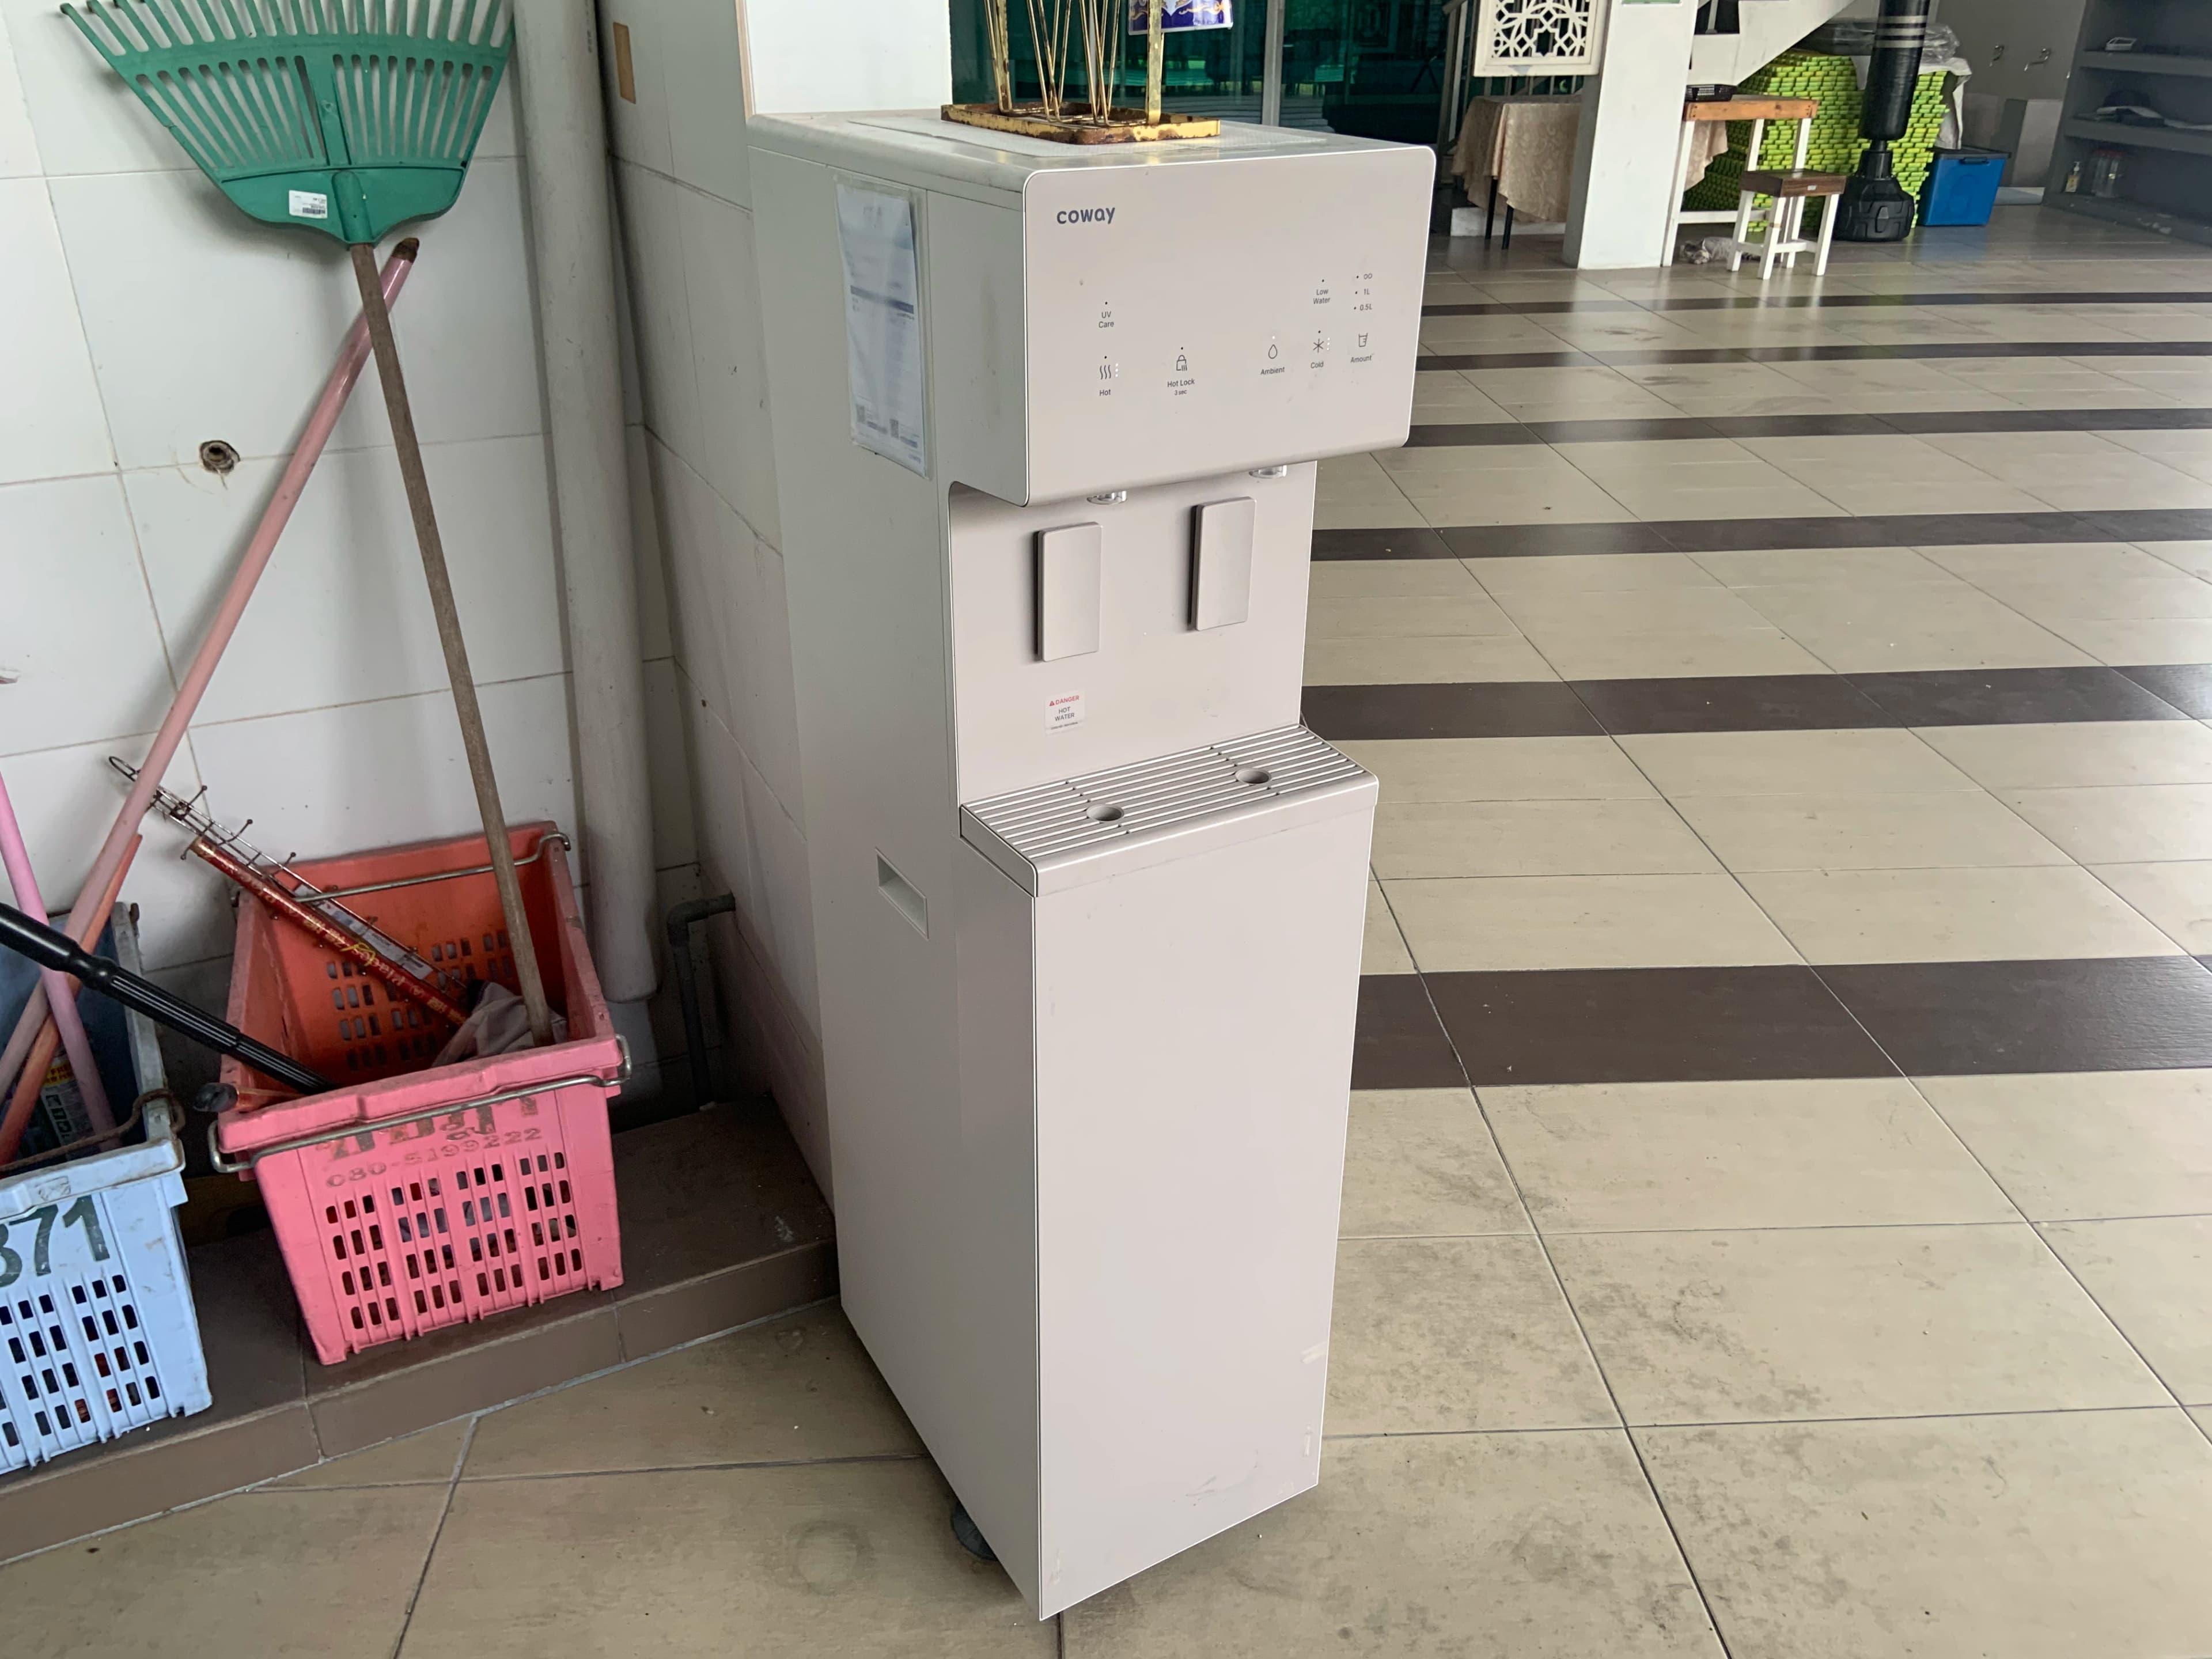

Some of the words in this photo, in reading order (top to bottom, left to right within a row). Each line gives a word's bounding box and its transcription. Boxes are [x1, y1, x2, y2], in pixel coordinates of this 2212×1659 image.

[1056, 207, 1115, 224] coway
[1313, 297, 1331, 305] Water
[1359, 303, 1373, 311] 0.5L
[1101, 310, 1112, 319] UV
[1098, 320, 1115, 328] Care
[1350, 355, 1372, 363] Amount
[1310, 361, 1324, 369] Cold
[1260, 366, 1285, 376] Ambient
[1167, 380, 1179, 388] Hot
[1180, 378, 1195, 387] Lock
[1099, 388, 1111, 396] Hot
[1055, 695, 1080, 705] DANGER
[1058, 706, 1071, 714] HOT
[1055, 712, 1075, 722] WATER
